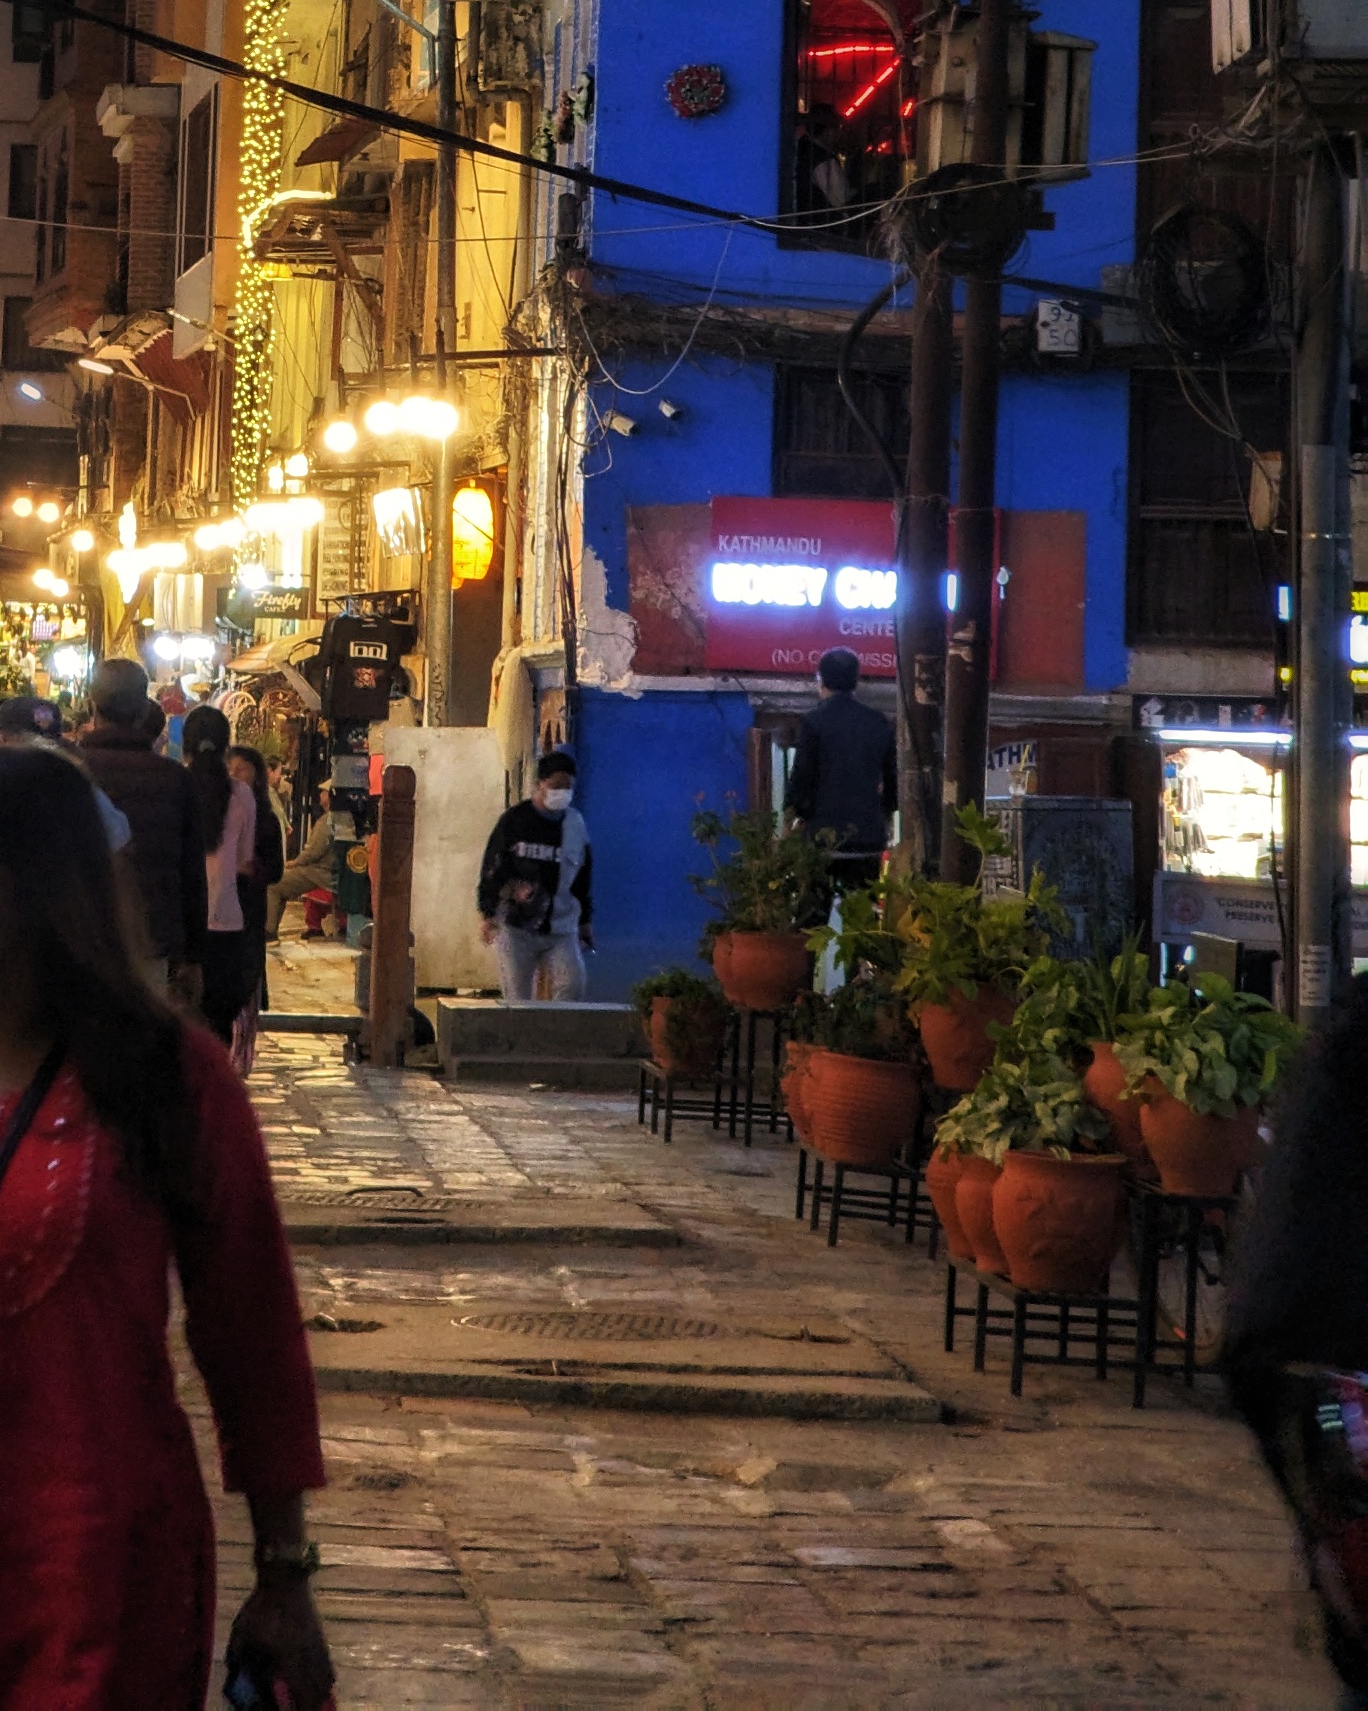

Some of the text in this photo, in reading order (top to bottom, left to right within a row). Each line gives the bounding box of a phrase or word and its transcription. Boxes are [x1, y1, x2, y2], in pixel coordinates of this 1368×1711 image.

[718, 535, 822, 555] KATHMANDU
[251, 590, 302, 611] Firefly
[839, 620, 895, 636] CENTE
